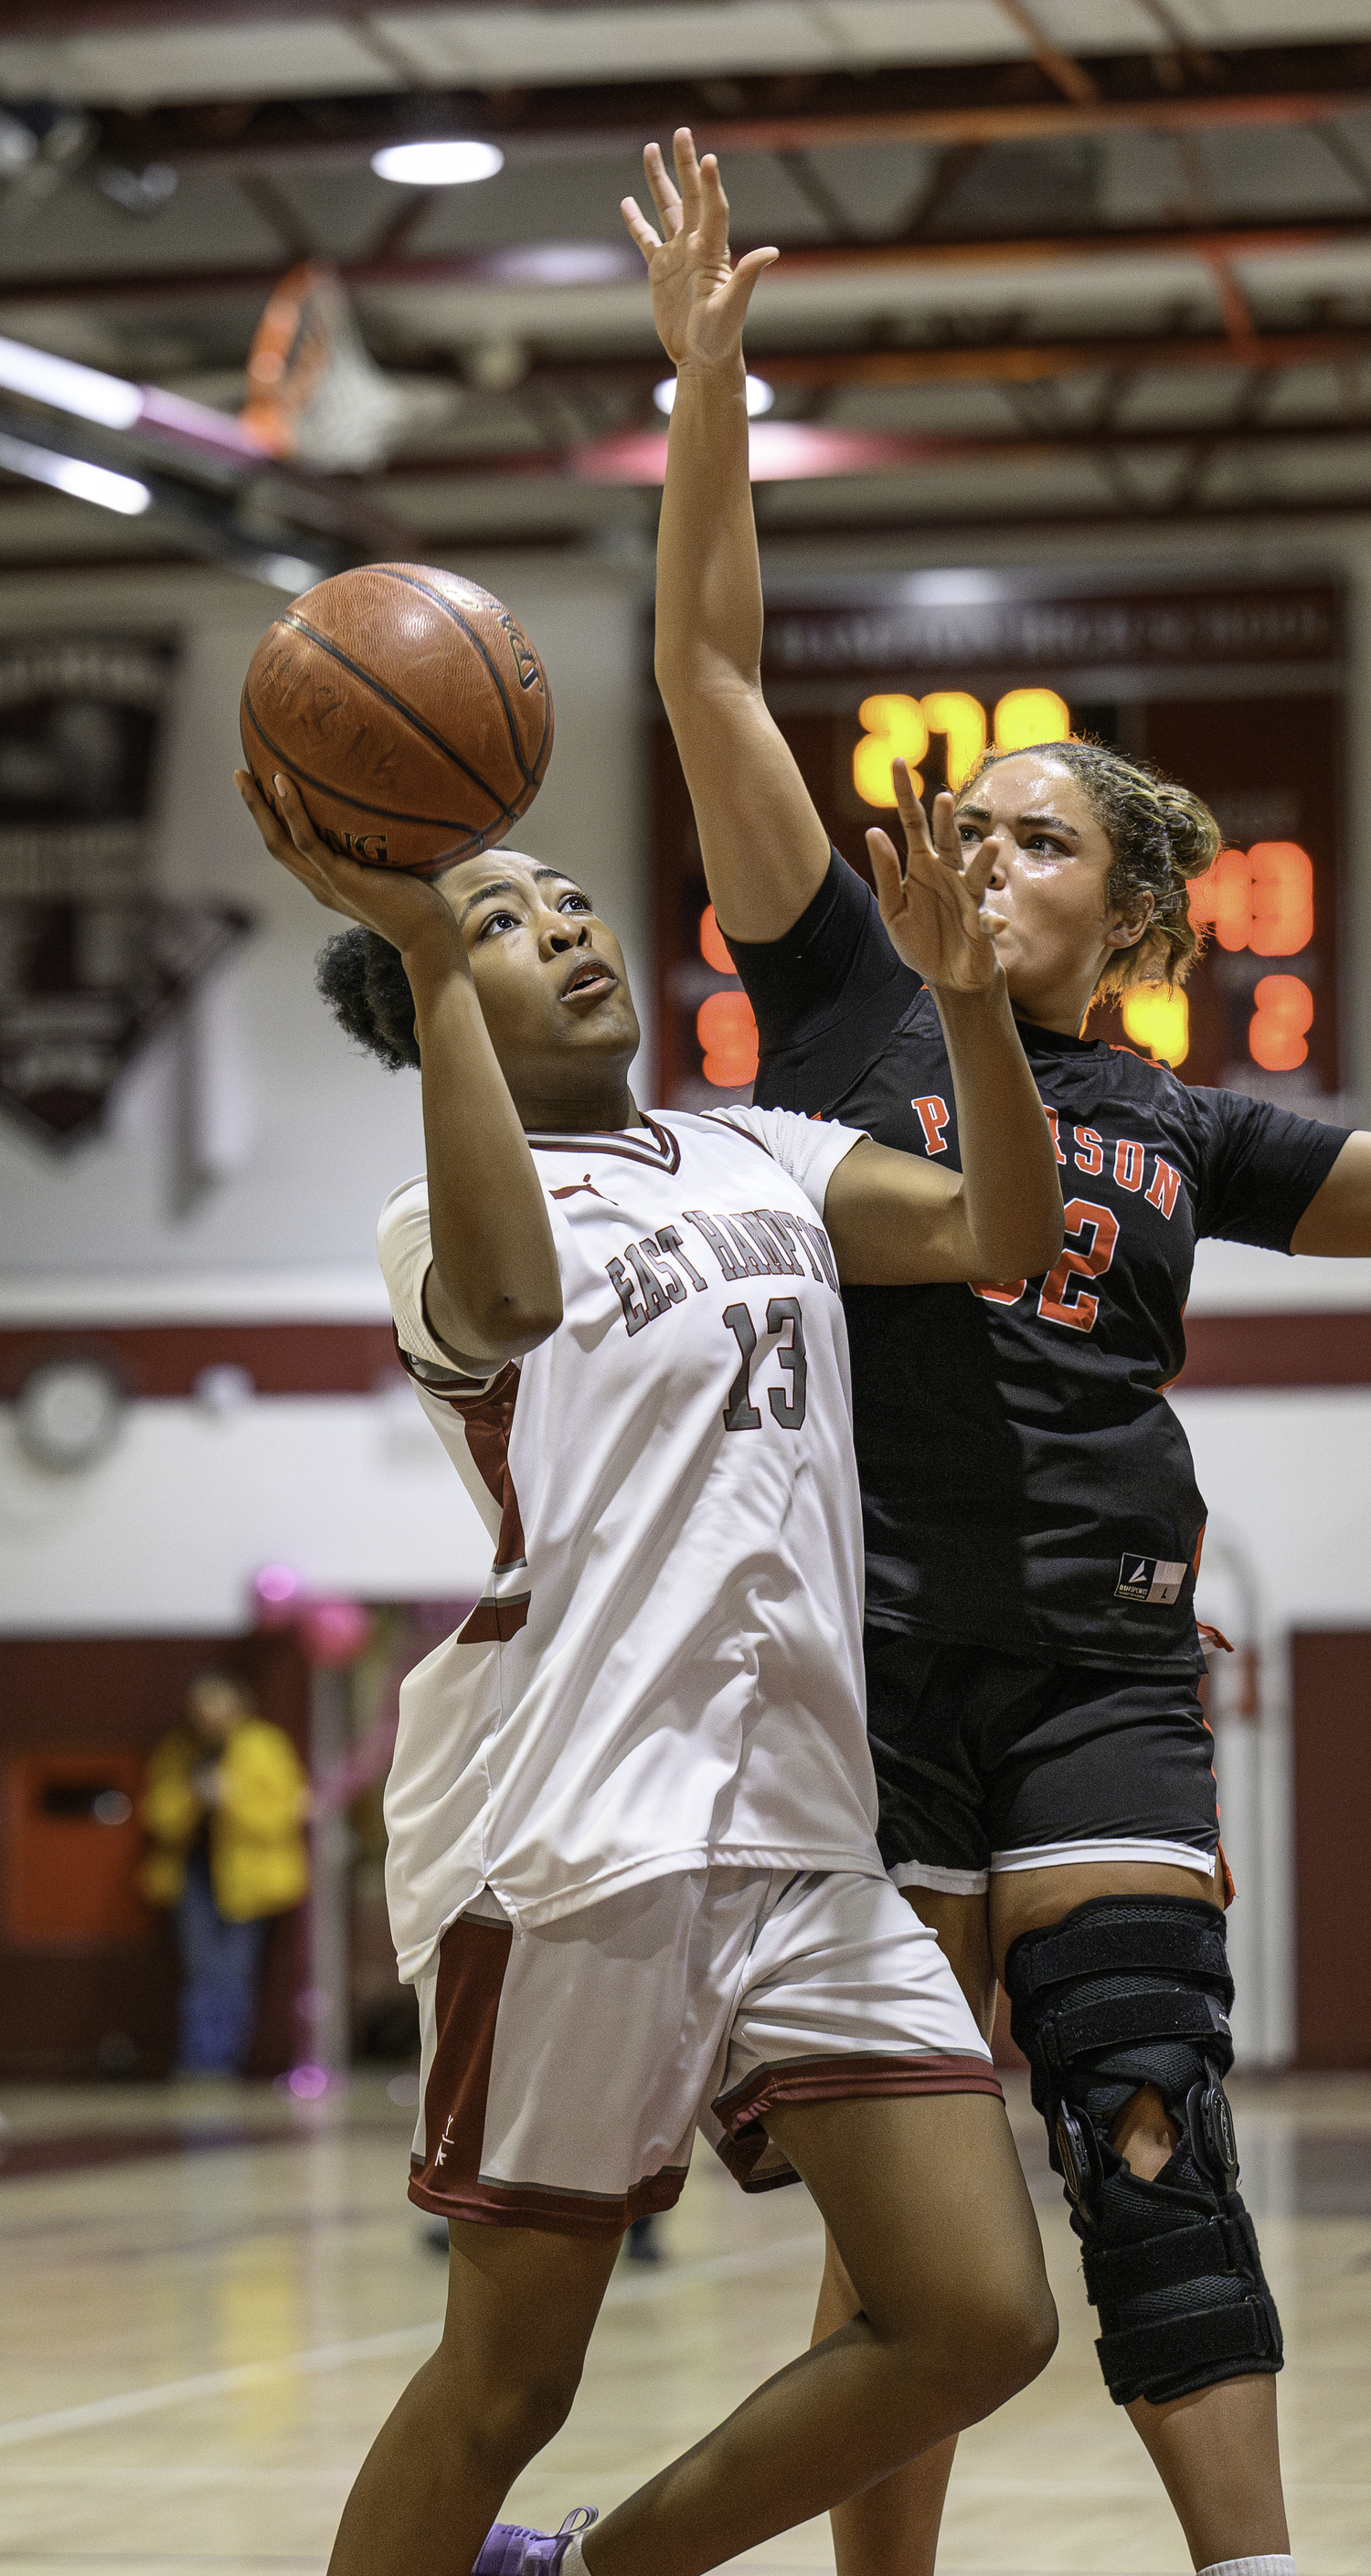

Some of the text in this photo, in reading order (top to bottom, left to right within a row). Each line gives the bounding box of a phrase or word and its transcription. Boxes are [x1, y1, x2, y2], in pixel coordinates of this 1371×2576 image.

[911, 1095, 1181, 1220] PSON
[605, 1224, 708, 1337] EAST
[967, 1197, 1121, 1333] 2
[721, 1296, 808, 1432] 13
